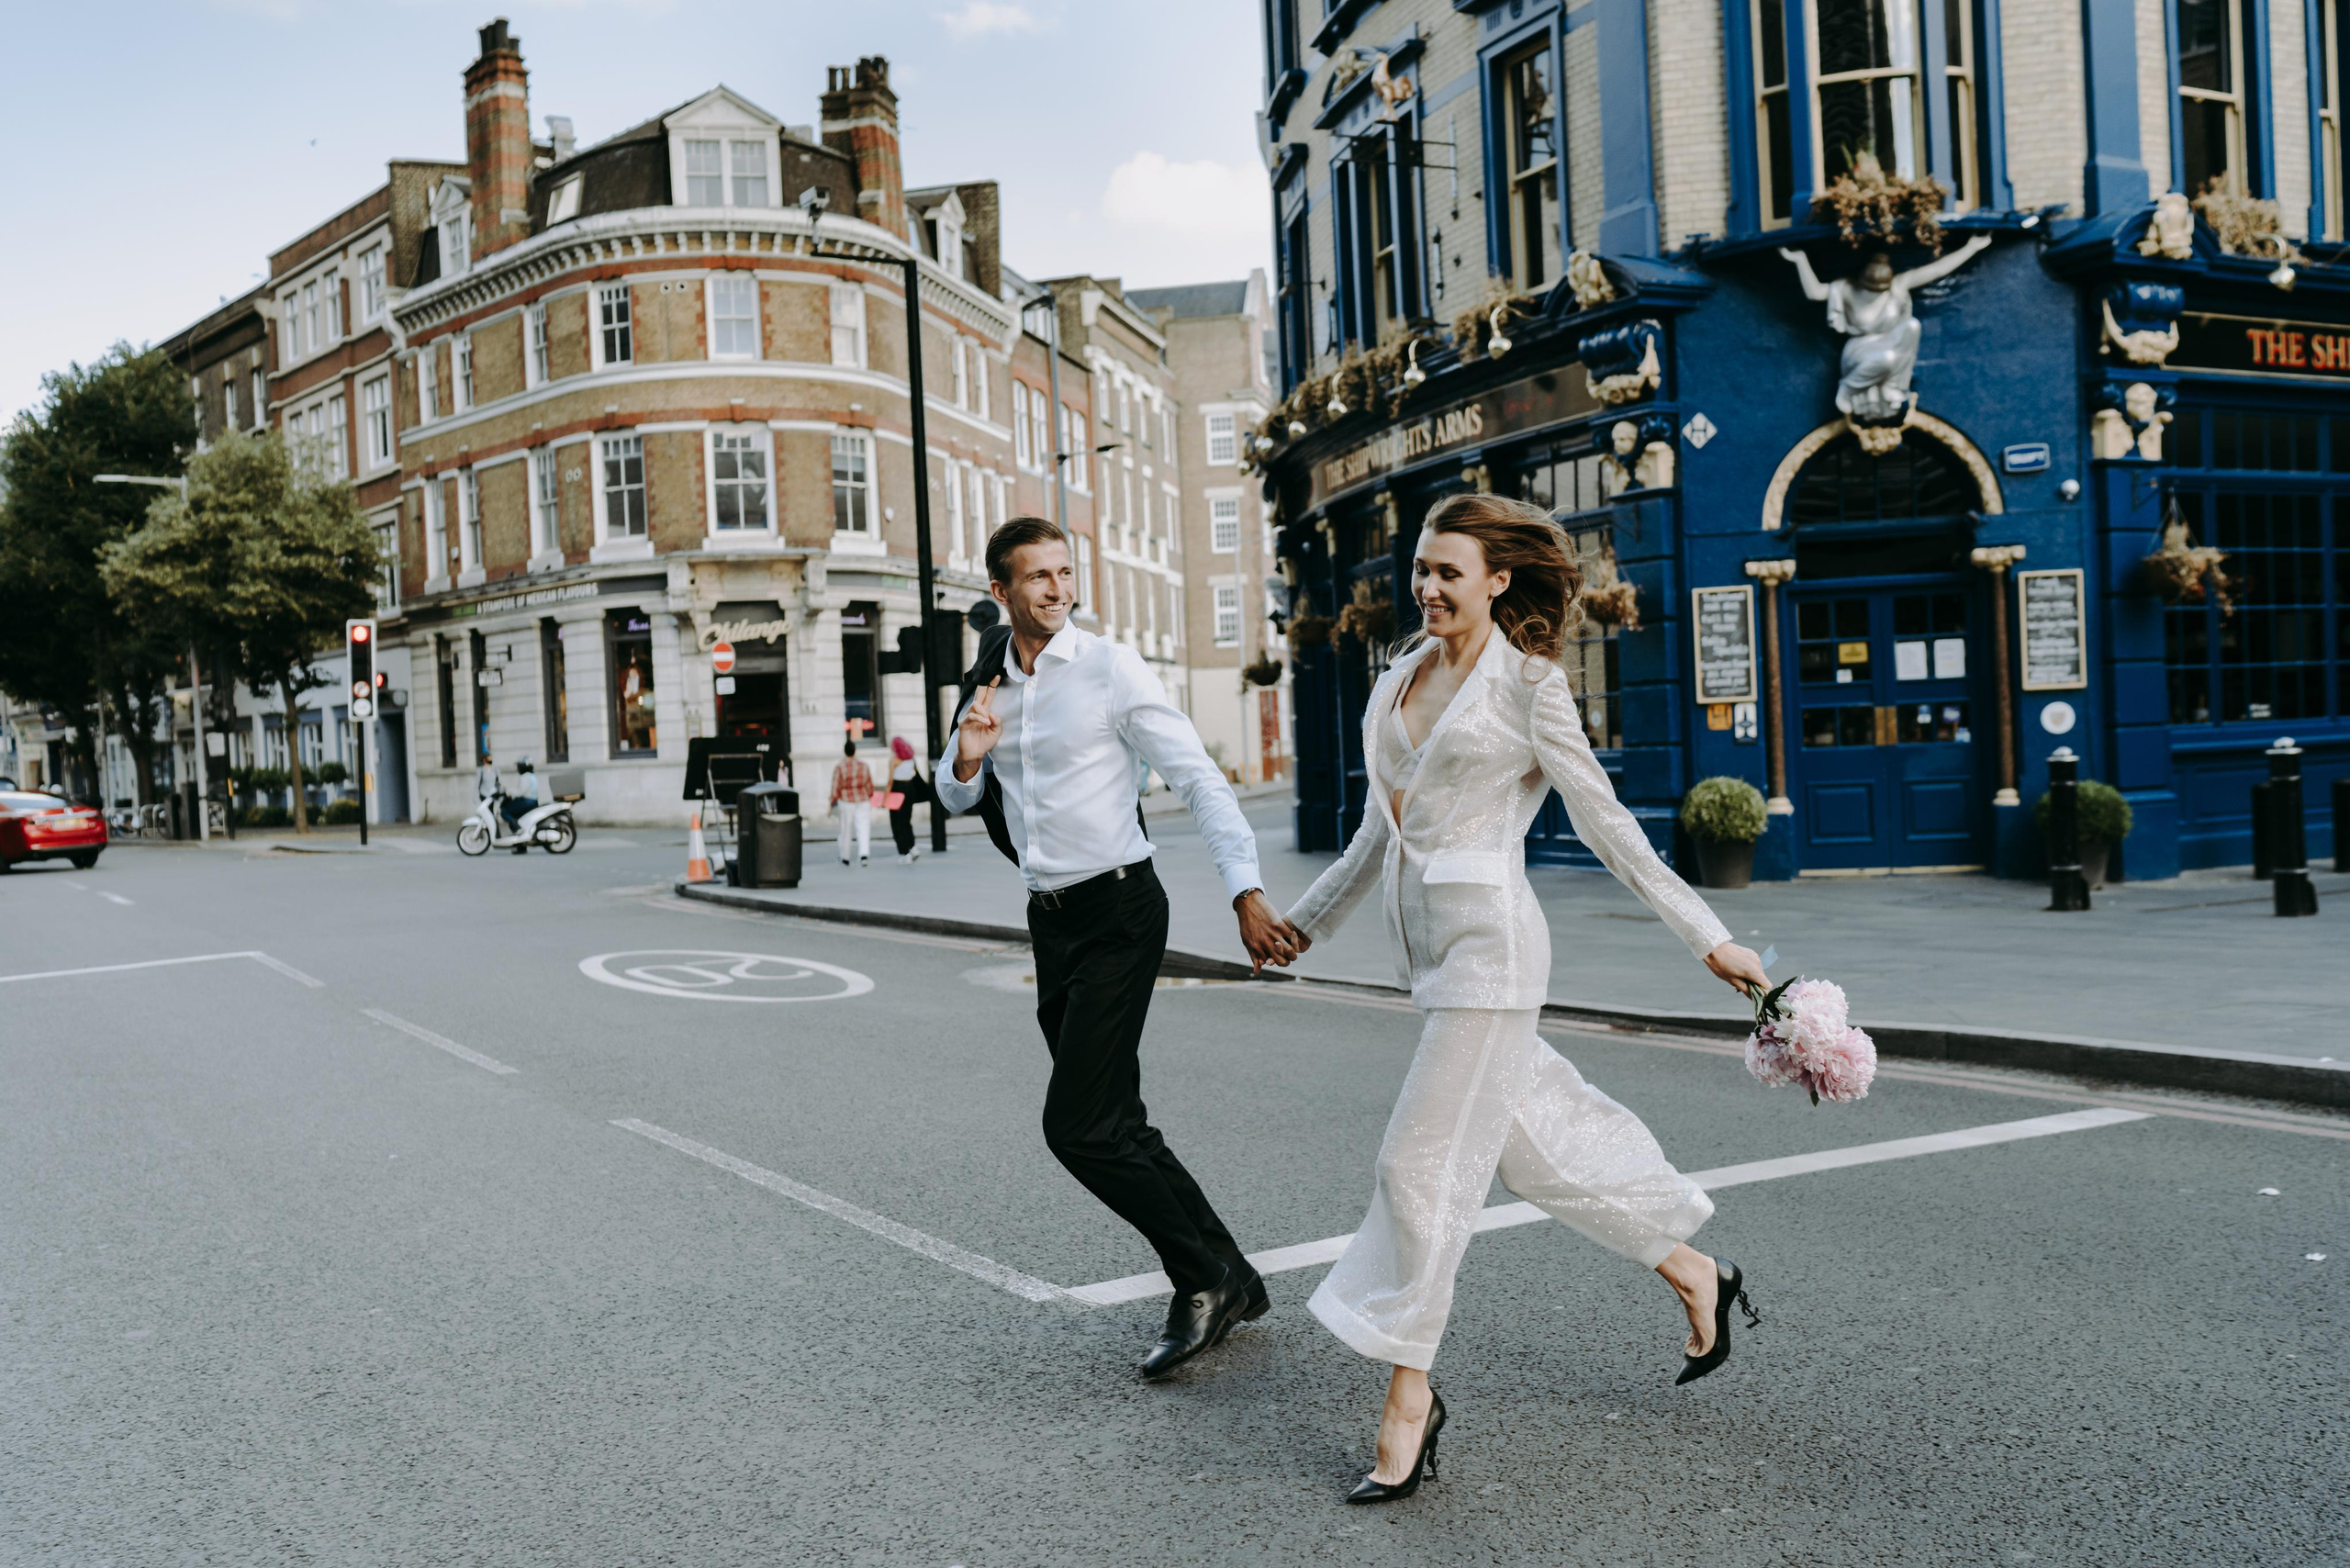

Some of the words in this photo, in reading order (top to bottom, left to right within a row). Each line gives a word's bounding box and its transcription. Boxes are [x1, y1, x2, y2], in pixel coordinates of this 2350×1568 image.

[2246, 329, 2306, 366] THE
[1325, 459, 1346, 489] THE
[1434, 403, 1483, 447] ARMS
[476, 601, 482, 615] A
[482, 596, 515, 614] STAMPEDE
[516, 594, 525, 609] OF
[526, 588, 556, 607] MEXICAN
[557, 582, 599, 601] FLAVOURS
[698, 618, 792, 652] Chilango
